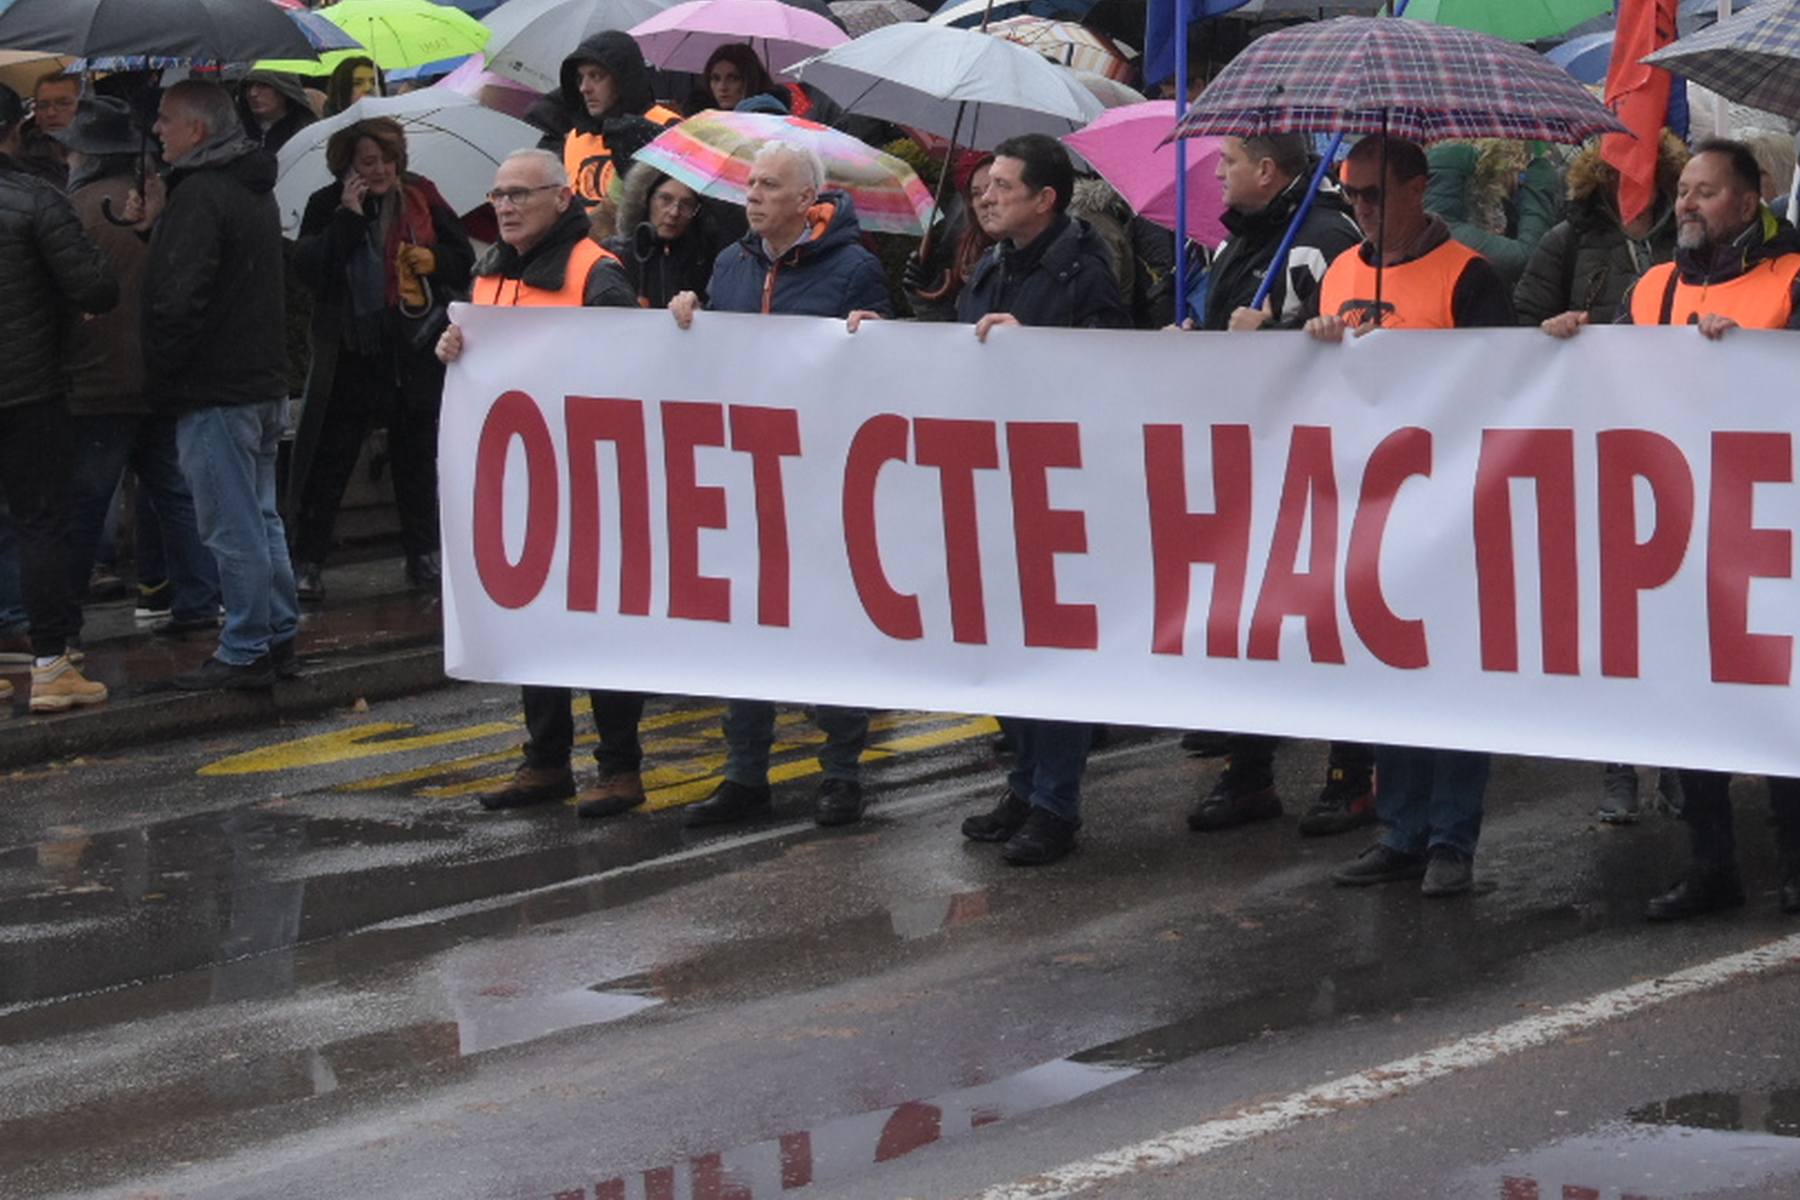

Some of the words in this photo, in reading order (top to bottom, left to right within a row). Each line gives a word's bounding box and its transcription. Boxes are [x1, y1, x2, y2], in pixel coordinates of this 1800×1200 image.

[474, 390, 802, 627] ОПЕТ
[844, 413, 1099, 650] СТЕ
[1145, 423, 1433, 670] НАС
